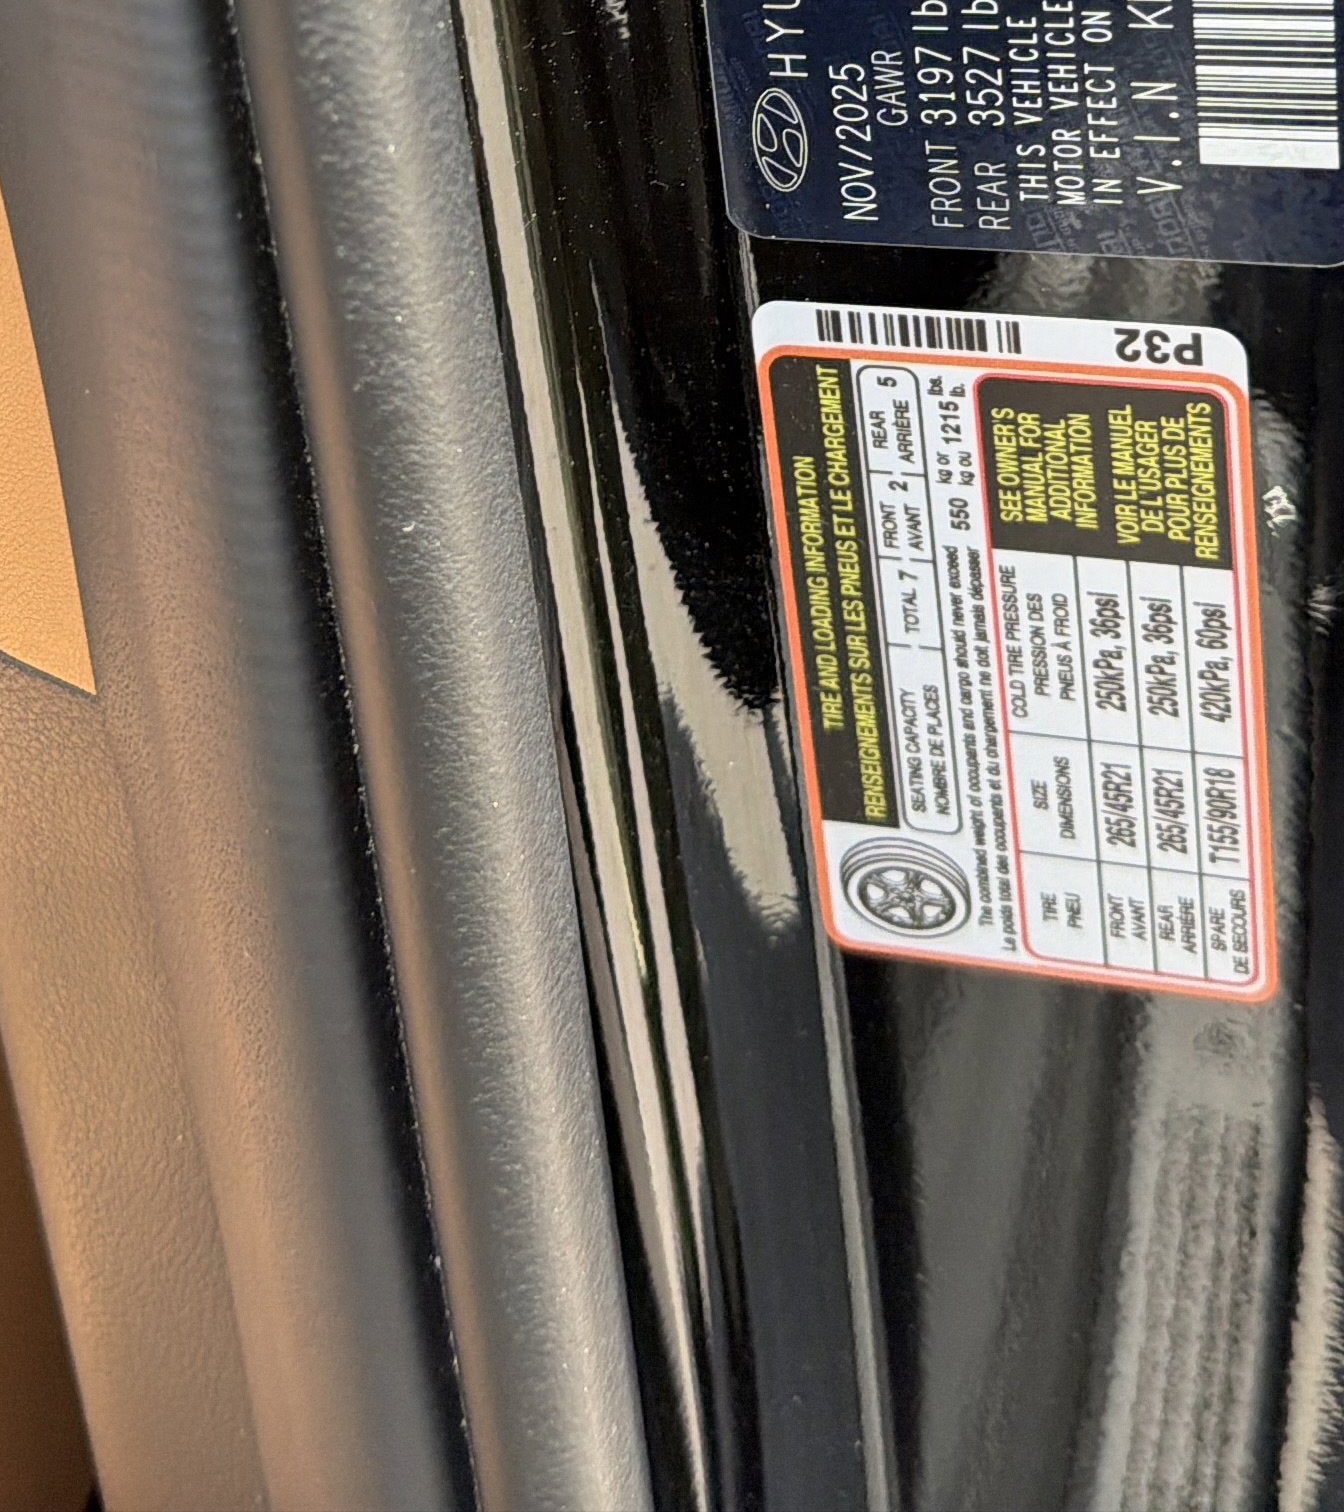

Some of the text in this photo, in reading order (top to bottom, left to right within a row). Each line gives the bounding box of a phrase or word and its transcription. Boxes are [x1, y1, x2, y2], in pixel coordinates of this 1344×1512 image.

[1041, 0, 1080, 110] VEHICLE
[1080, 11, 1113, 43] ON
[870, 50, 909, 126] GAWR
[1005, 15, 1044, 126] VEHICLE
[1083, 62, 1121, 159] EFFECT
[828, 63, 879, 221] NOV/2025
[924, 139, 965, 228] FRONT
[1015, 144, 1050, 202] THIS
[1051, 128, 1087, 206] MOTOR
[973, 162, 1012, 230] REAR
[1091, 178, 1124, 205] IN
[876, 376, 898, 388] 5
[927, 375, 944, 396] lbs.
[1114, 327, 1204, 367] P32
[868, 410, 889, 450] REAR
[938, 400, 962, 445] 1215
[949, 383, 966, 398] lb.
[936, 451, 953, 485] kg or
[958, 450, 976, 487] kg ou
[990, 407, 1024, 522] SEE OWNER'S
[1016, 412, 1049, 523] MANUAL FOR
[1042, 418, 1073, 521] ADDITIONAL
[1067, 413, 1099, 529] INFORMATION
[1108, 404, 1141, 544] VOIR LE MANUEL
[1134, 420, 1165, 533] DE L'USAGER
[1160, 416, 1192, 542] POUR PLUS DE
[1185, 402, 1220, 560] RENSEIGNEMENTS
[879, 501, 900, 550] FRONT
[887, 480, 924, 552] AVANT 2
[948, 497, 971, 531] 550
[792, 455, 844, 729] TIRE AND LOADING INFORMATION
[815, 364, 887, 819] RENSEIGNEMENTS SUR LES PNEUS ET LE CHARGEMENT
[897, 569, 920, 634] TOTAL 7
[998, 565, 1029, 719] COLD TIRE PRESSURE
[1025, 592, 1050, 697] PRESSION DES
[1049, 593, 1076, 702] PNEUS À FROID
[1086, 591, 1127, 713] 250kPa, 36psi
[1139, 596, 1180, 718] 250kPa, 36psi
[1193, 601, 1233, 724] 420kPa, 60psi
[899, 688, 928, 814] SEATING CAPACITY
[922, 684, 951, 816] NOMBRE DE PLACES
[1030, 779, 1050, 811] SIZE
[1053, 756, 1076, 840] DIMENSIONS
[1100, 762, 1137, 848] 265/45R21
[1152, 768, 1189, 855] 265/45R21
[1203, 767, 1241, 864] T155/90R18
[1040, 892, 1059, 922] TIRE
[1065, 892, 1083, 929] PNEU
[1107, 893, 1126, 939] FRONT
[1128, 897, 1147, 942] AVANT
[1156, 905, 1176, 942] REAR
[1208, 907, 1228, 952] SPARE
[1228, 889, 1250, 976] DE SECOURS
